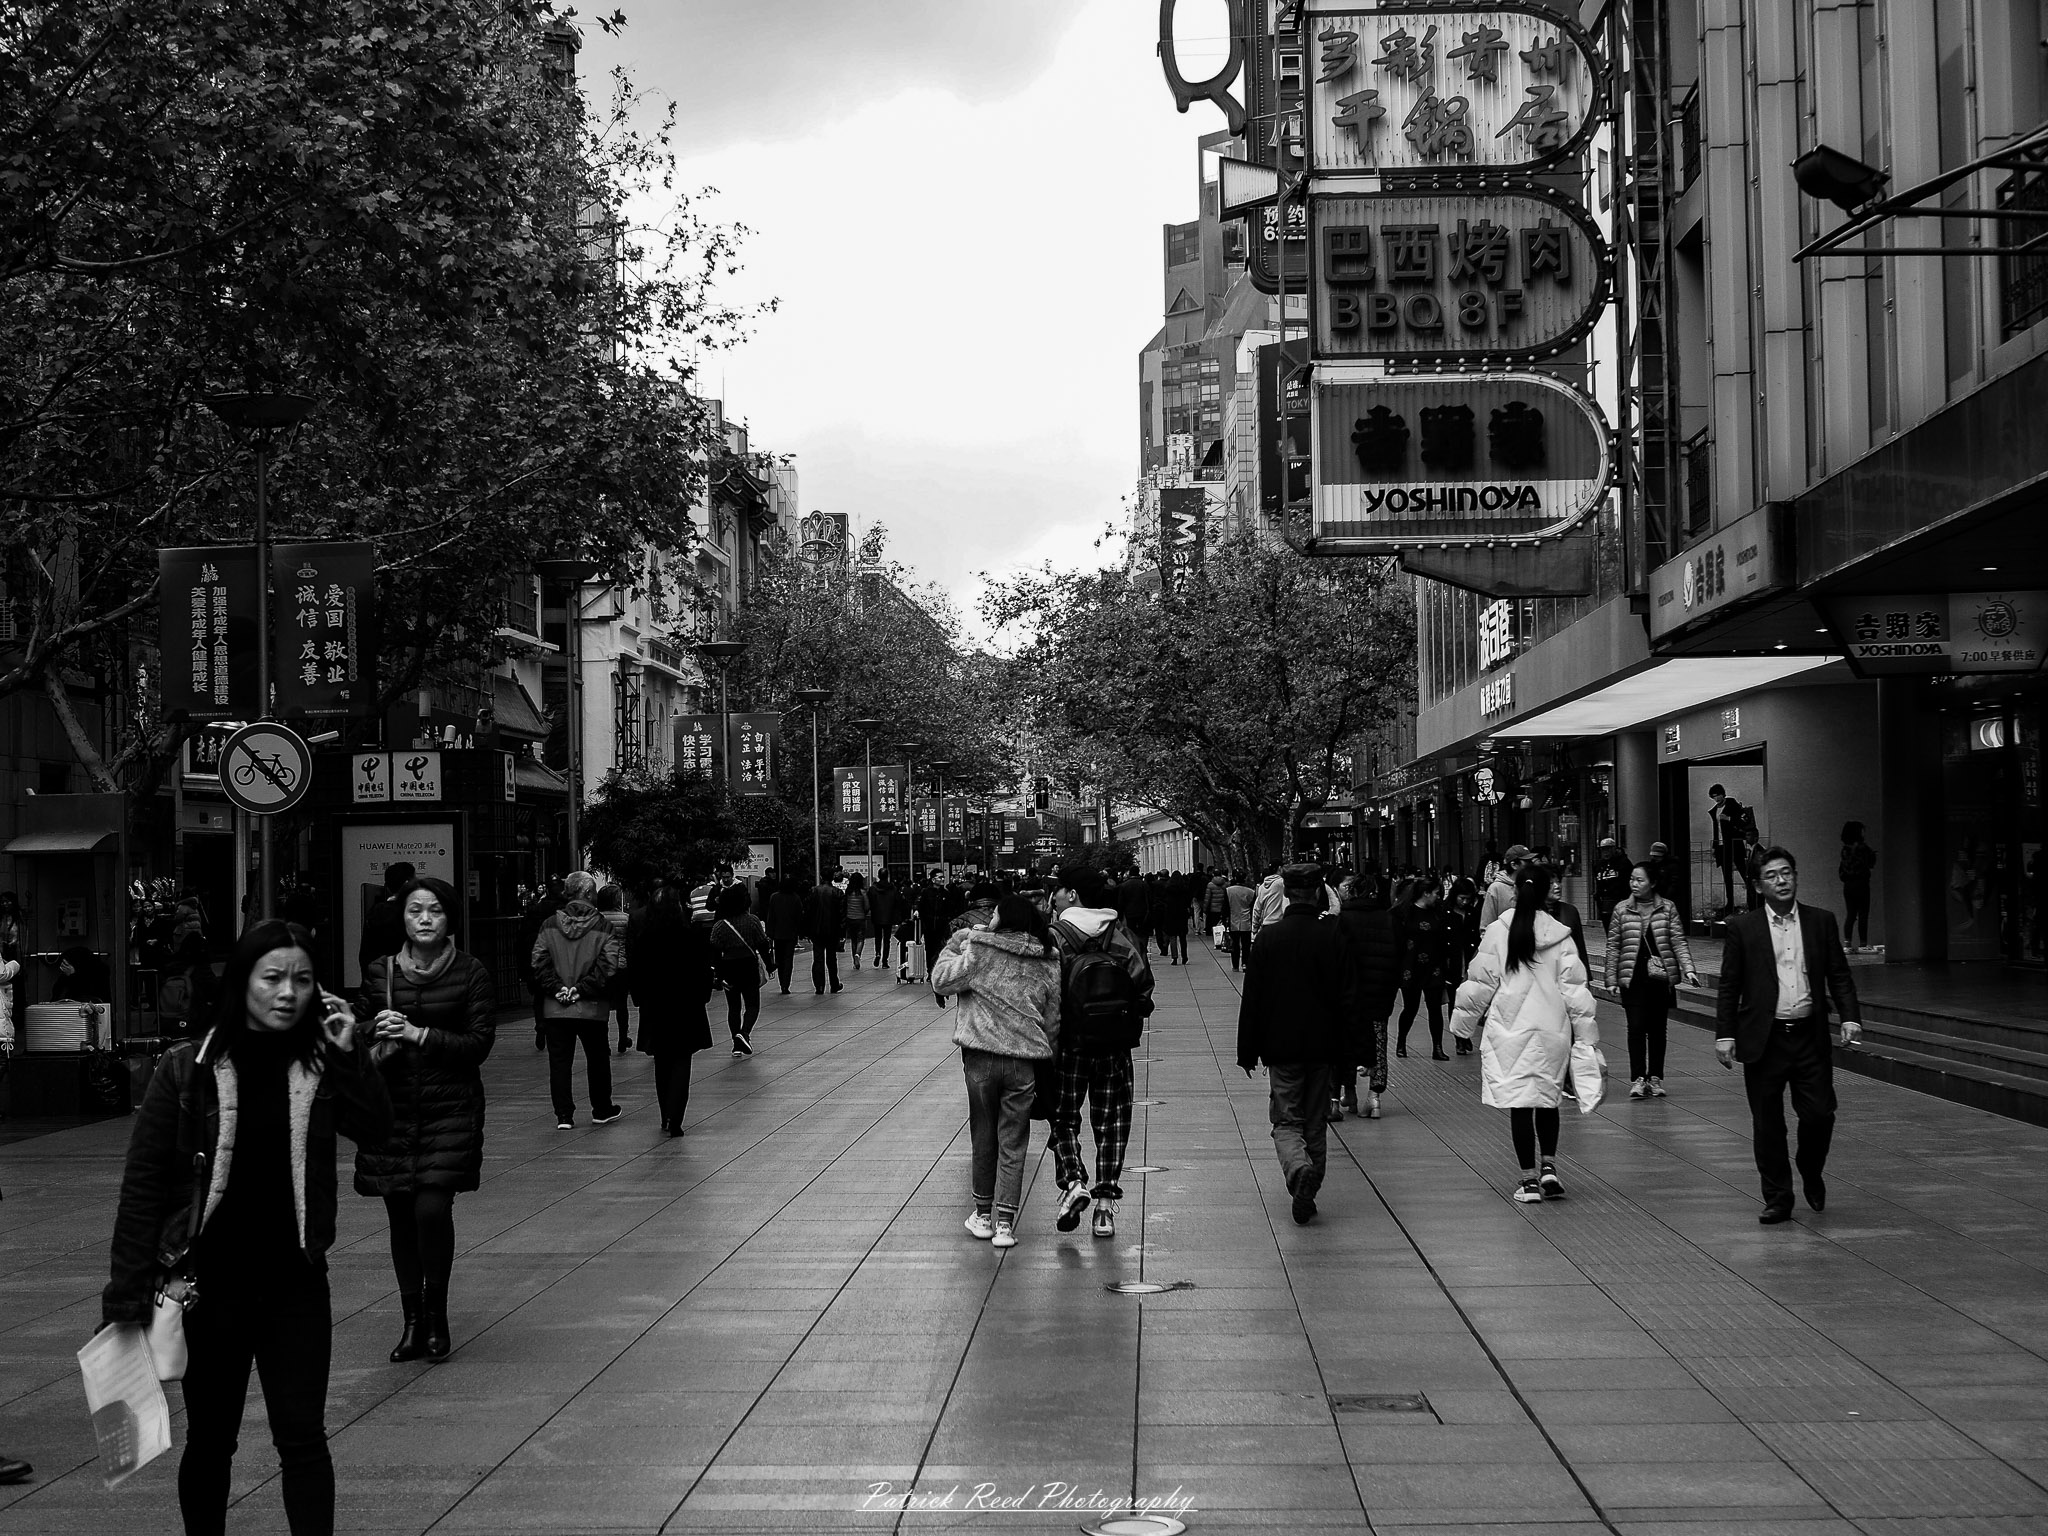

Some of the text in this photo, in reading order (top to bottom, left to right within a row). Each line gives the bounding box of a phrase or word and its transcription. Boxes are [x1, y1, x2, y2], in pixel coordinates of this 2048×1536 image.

[1315, 24, 1574, 84] 多彩贵州
[1332, 86, 1568, 155] 干锅居
[1323, 217, 1570, 285] 巴西烤肉
[1330, 289, 1522, 331] BBQ 8F
[1364, 486, 1542, 514] YOSHINOYA
[295, 584, 320, 629] 诚信
[324, 583, 345, 628] 爱国
[191, 587, 208, 693] 关爱未成年人健康成长
[1855, 611, 1941, 640] 吉野家
[212, 586, 230, 705] 加强未成年人思想道德建设
[323, 640, 348, 683] 敬业
[1859, 643, 1942, 657] YOSHINOYA
[1961, 648, 2036, 663] 7:00 早餐供应
[299, 640, 321, 686] 友善
[682, 734, 696, 771] 快乐志
[741, 732, 752, 753] 公正
[754, 732, 765, 753] 自由
[400, 780, 435, 792] 中国电信
[741, 760, 753, 782] 法治
[754, 758, 766, 782] 平等
[358, 782, 384, 793] 中国电信
[359, 842, 394, 850] HUAWEI
[396, 841, 423, 850] Mate20
